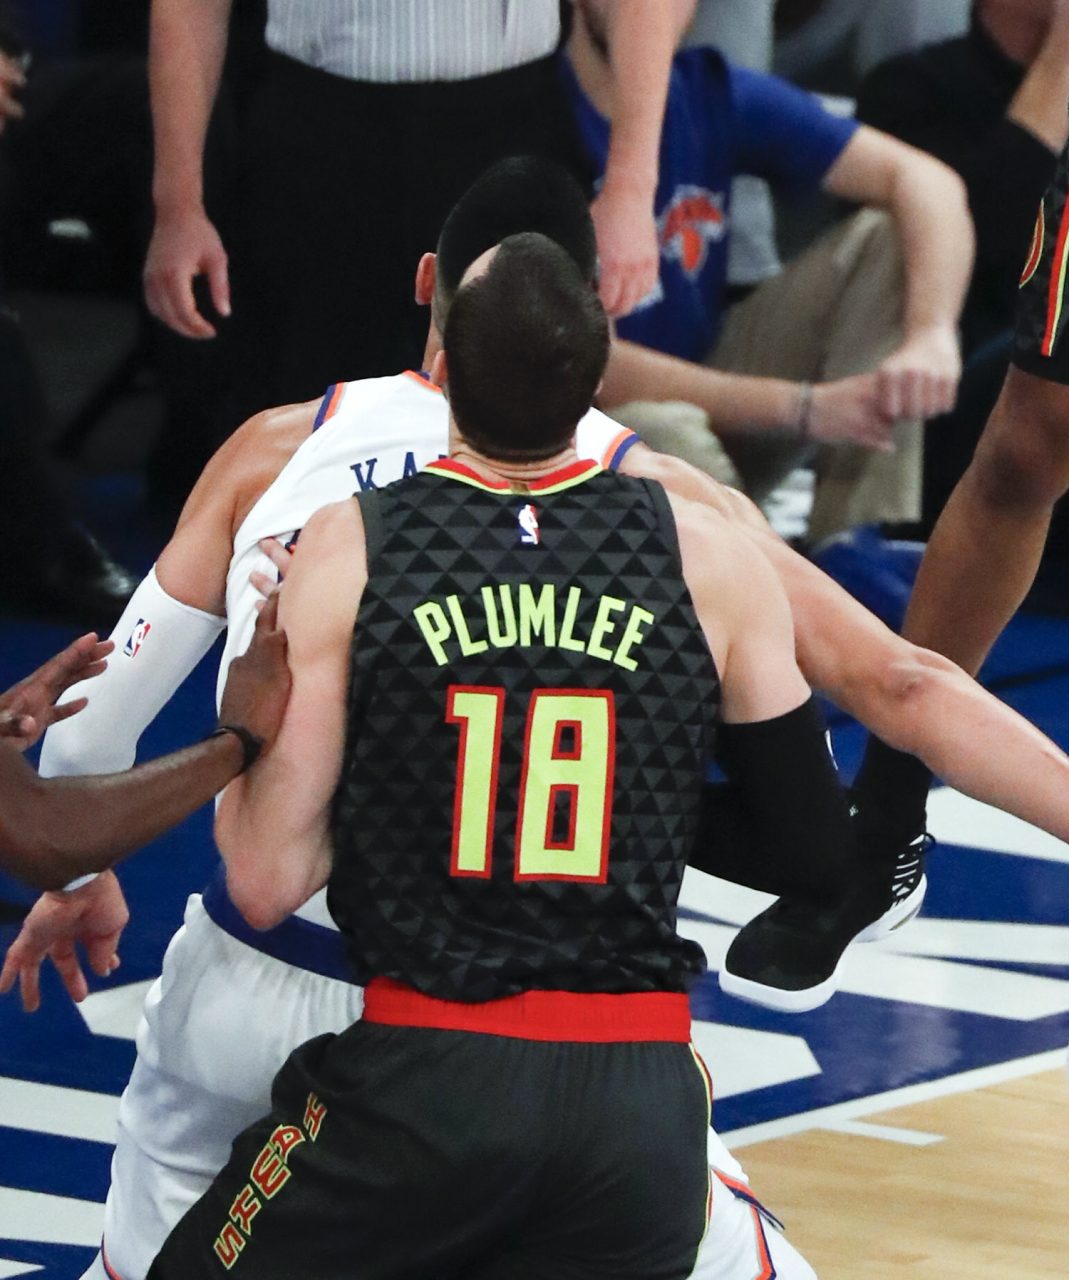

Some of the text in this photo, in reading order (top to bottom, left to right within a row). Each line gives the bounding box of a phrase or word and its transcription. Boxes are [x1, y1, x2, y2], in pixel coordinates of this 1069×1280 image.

[413, 584, 655, 671] PLUMLEE
[445, 685, 616, 883] 18
[213, 1091, 327, 1270] HAWKS
